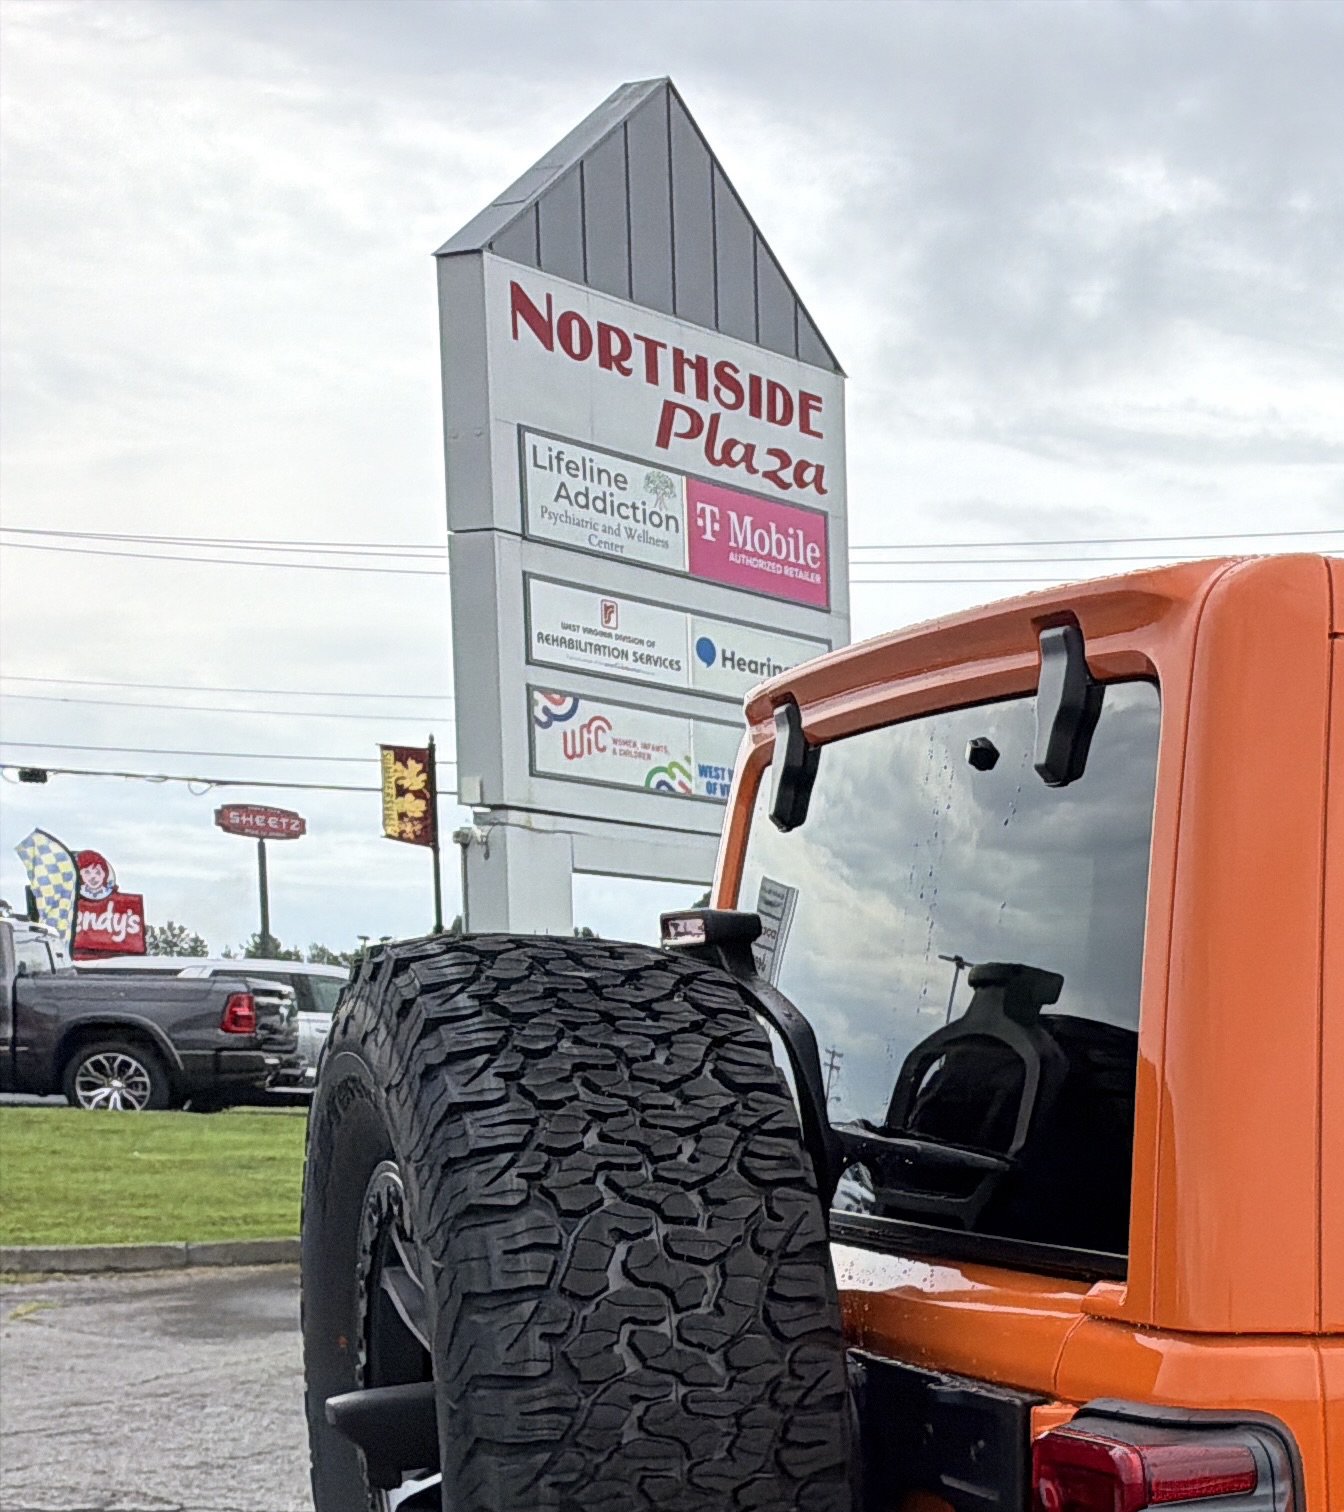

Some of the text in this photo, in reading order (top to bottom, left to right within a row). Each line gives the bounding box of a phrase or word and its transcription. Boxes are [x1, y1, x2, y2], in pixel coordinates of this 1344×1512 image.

[510, 280, 823, 439] NORTHSIDE
[532, 444, 628, 491] Lifeline
[655, 400, 828, 495] Plaza
[540, 505, 669, 549] Psychiatric and Wellness
[554, 481, 679, 533] Addiction
[588, 534, 624, 553] Center
[727, 510, 821, 568] Mobile
[728, 552, 821, 584] AUTHORIZED RETAILER
[537, 631, 629, 661] REHABILITATION
[632, 651, 682, 671] SERVICES
[698, 764, 725, 781] WEST
[228, 811, 301, 831] SHEETZ
[76, 900, 141, 943] endy's
